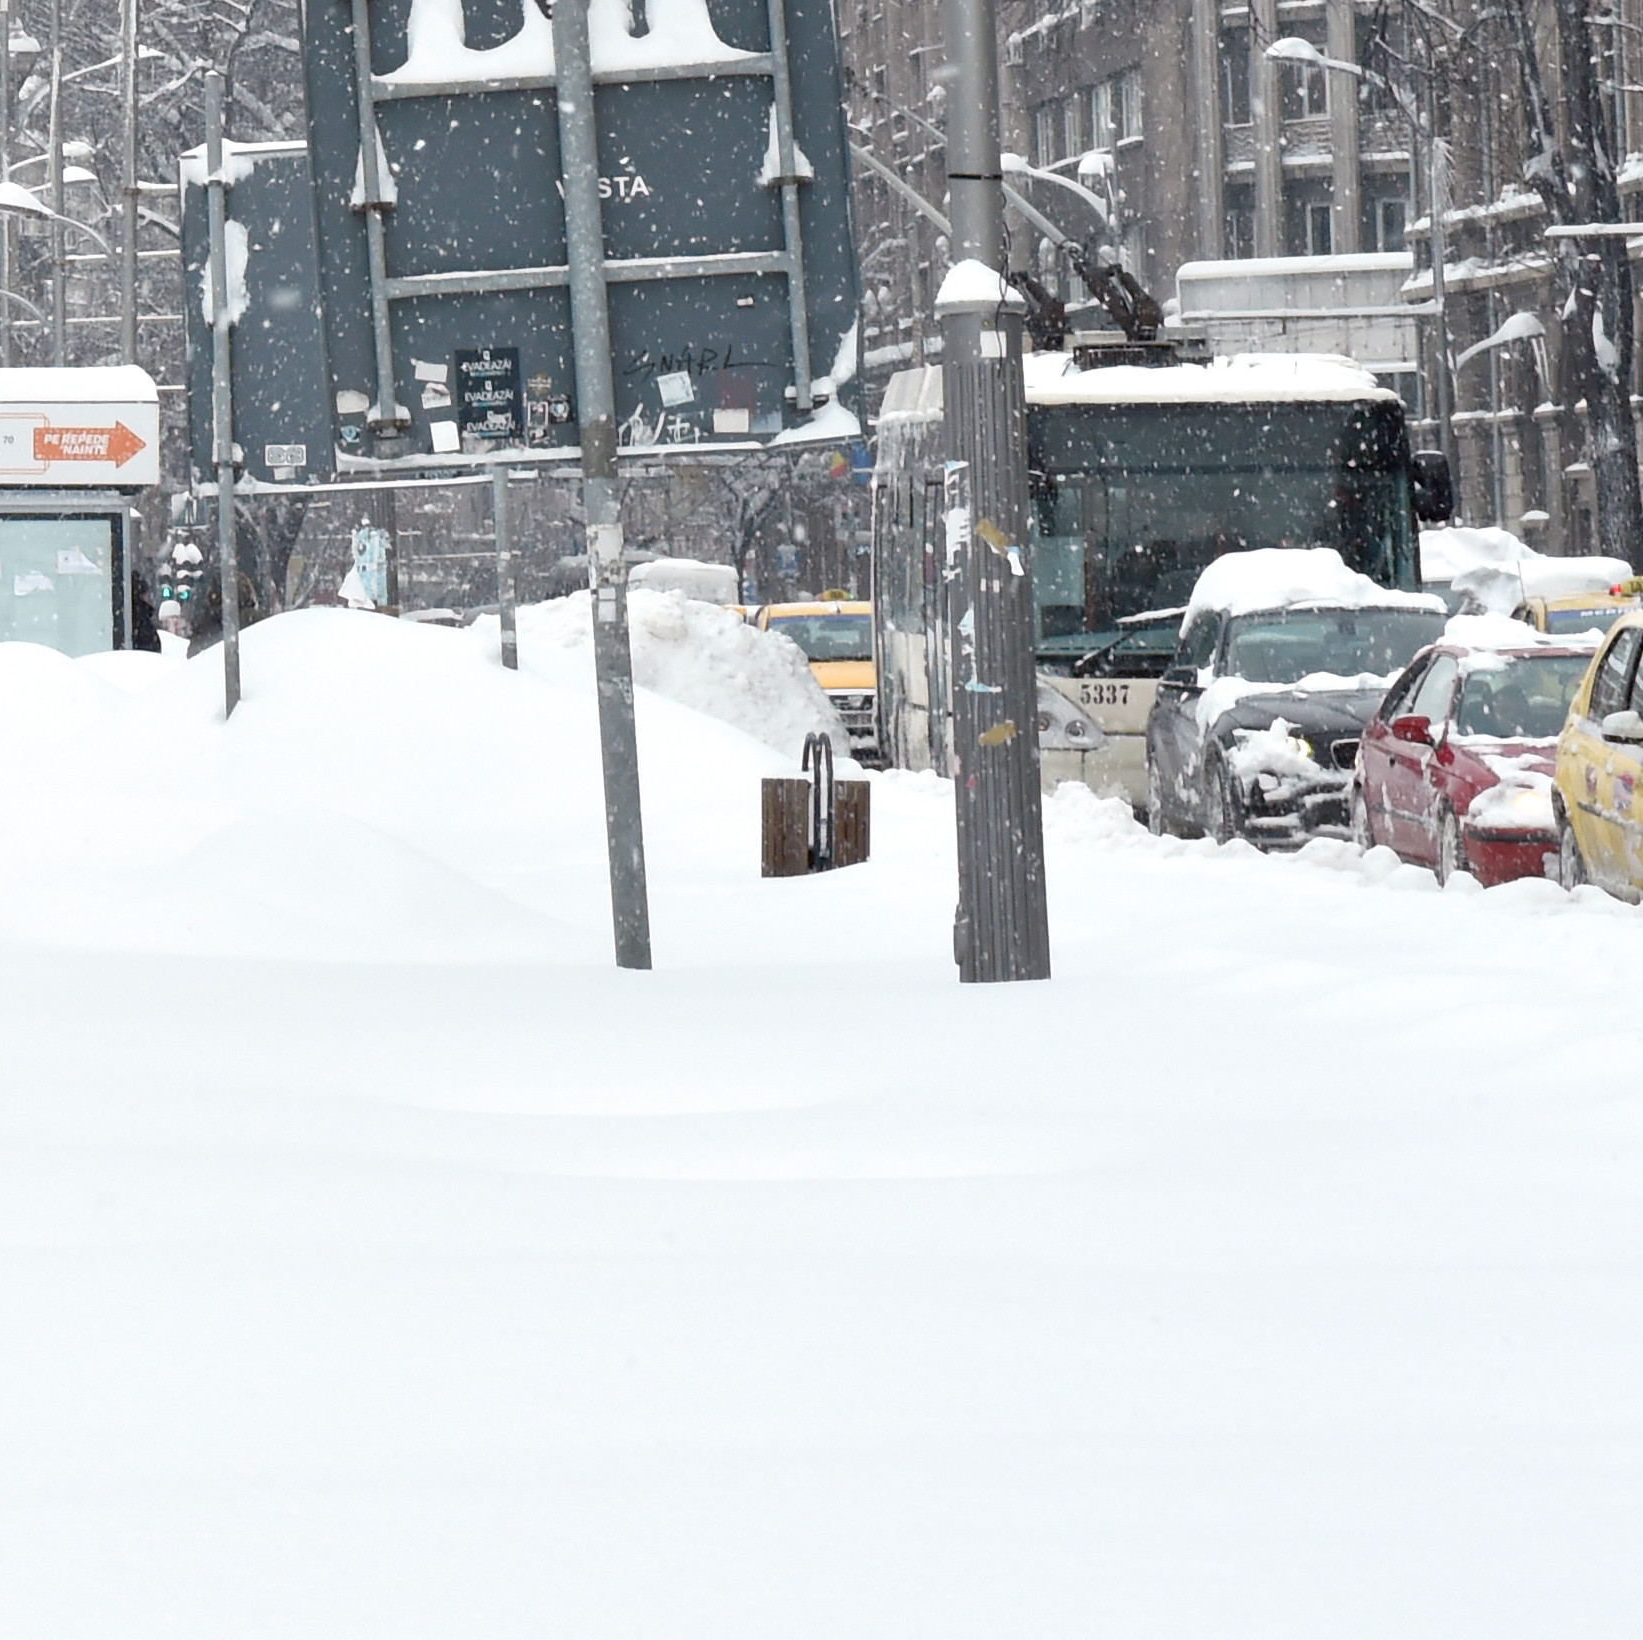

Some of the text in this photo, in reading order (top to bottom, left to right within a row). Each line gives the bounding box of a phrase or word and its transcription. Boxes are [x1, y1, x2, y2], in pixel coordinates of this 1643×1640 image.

[3, 435, 14, 444] 70
[43, 432, 110, 445] PE REPEDE
[1081, 684, 1129, 705] 5337
